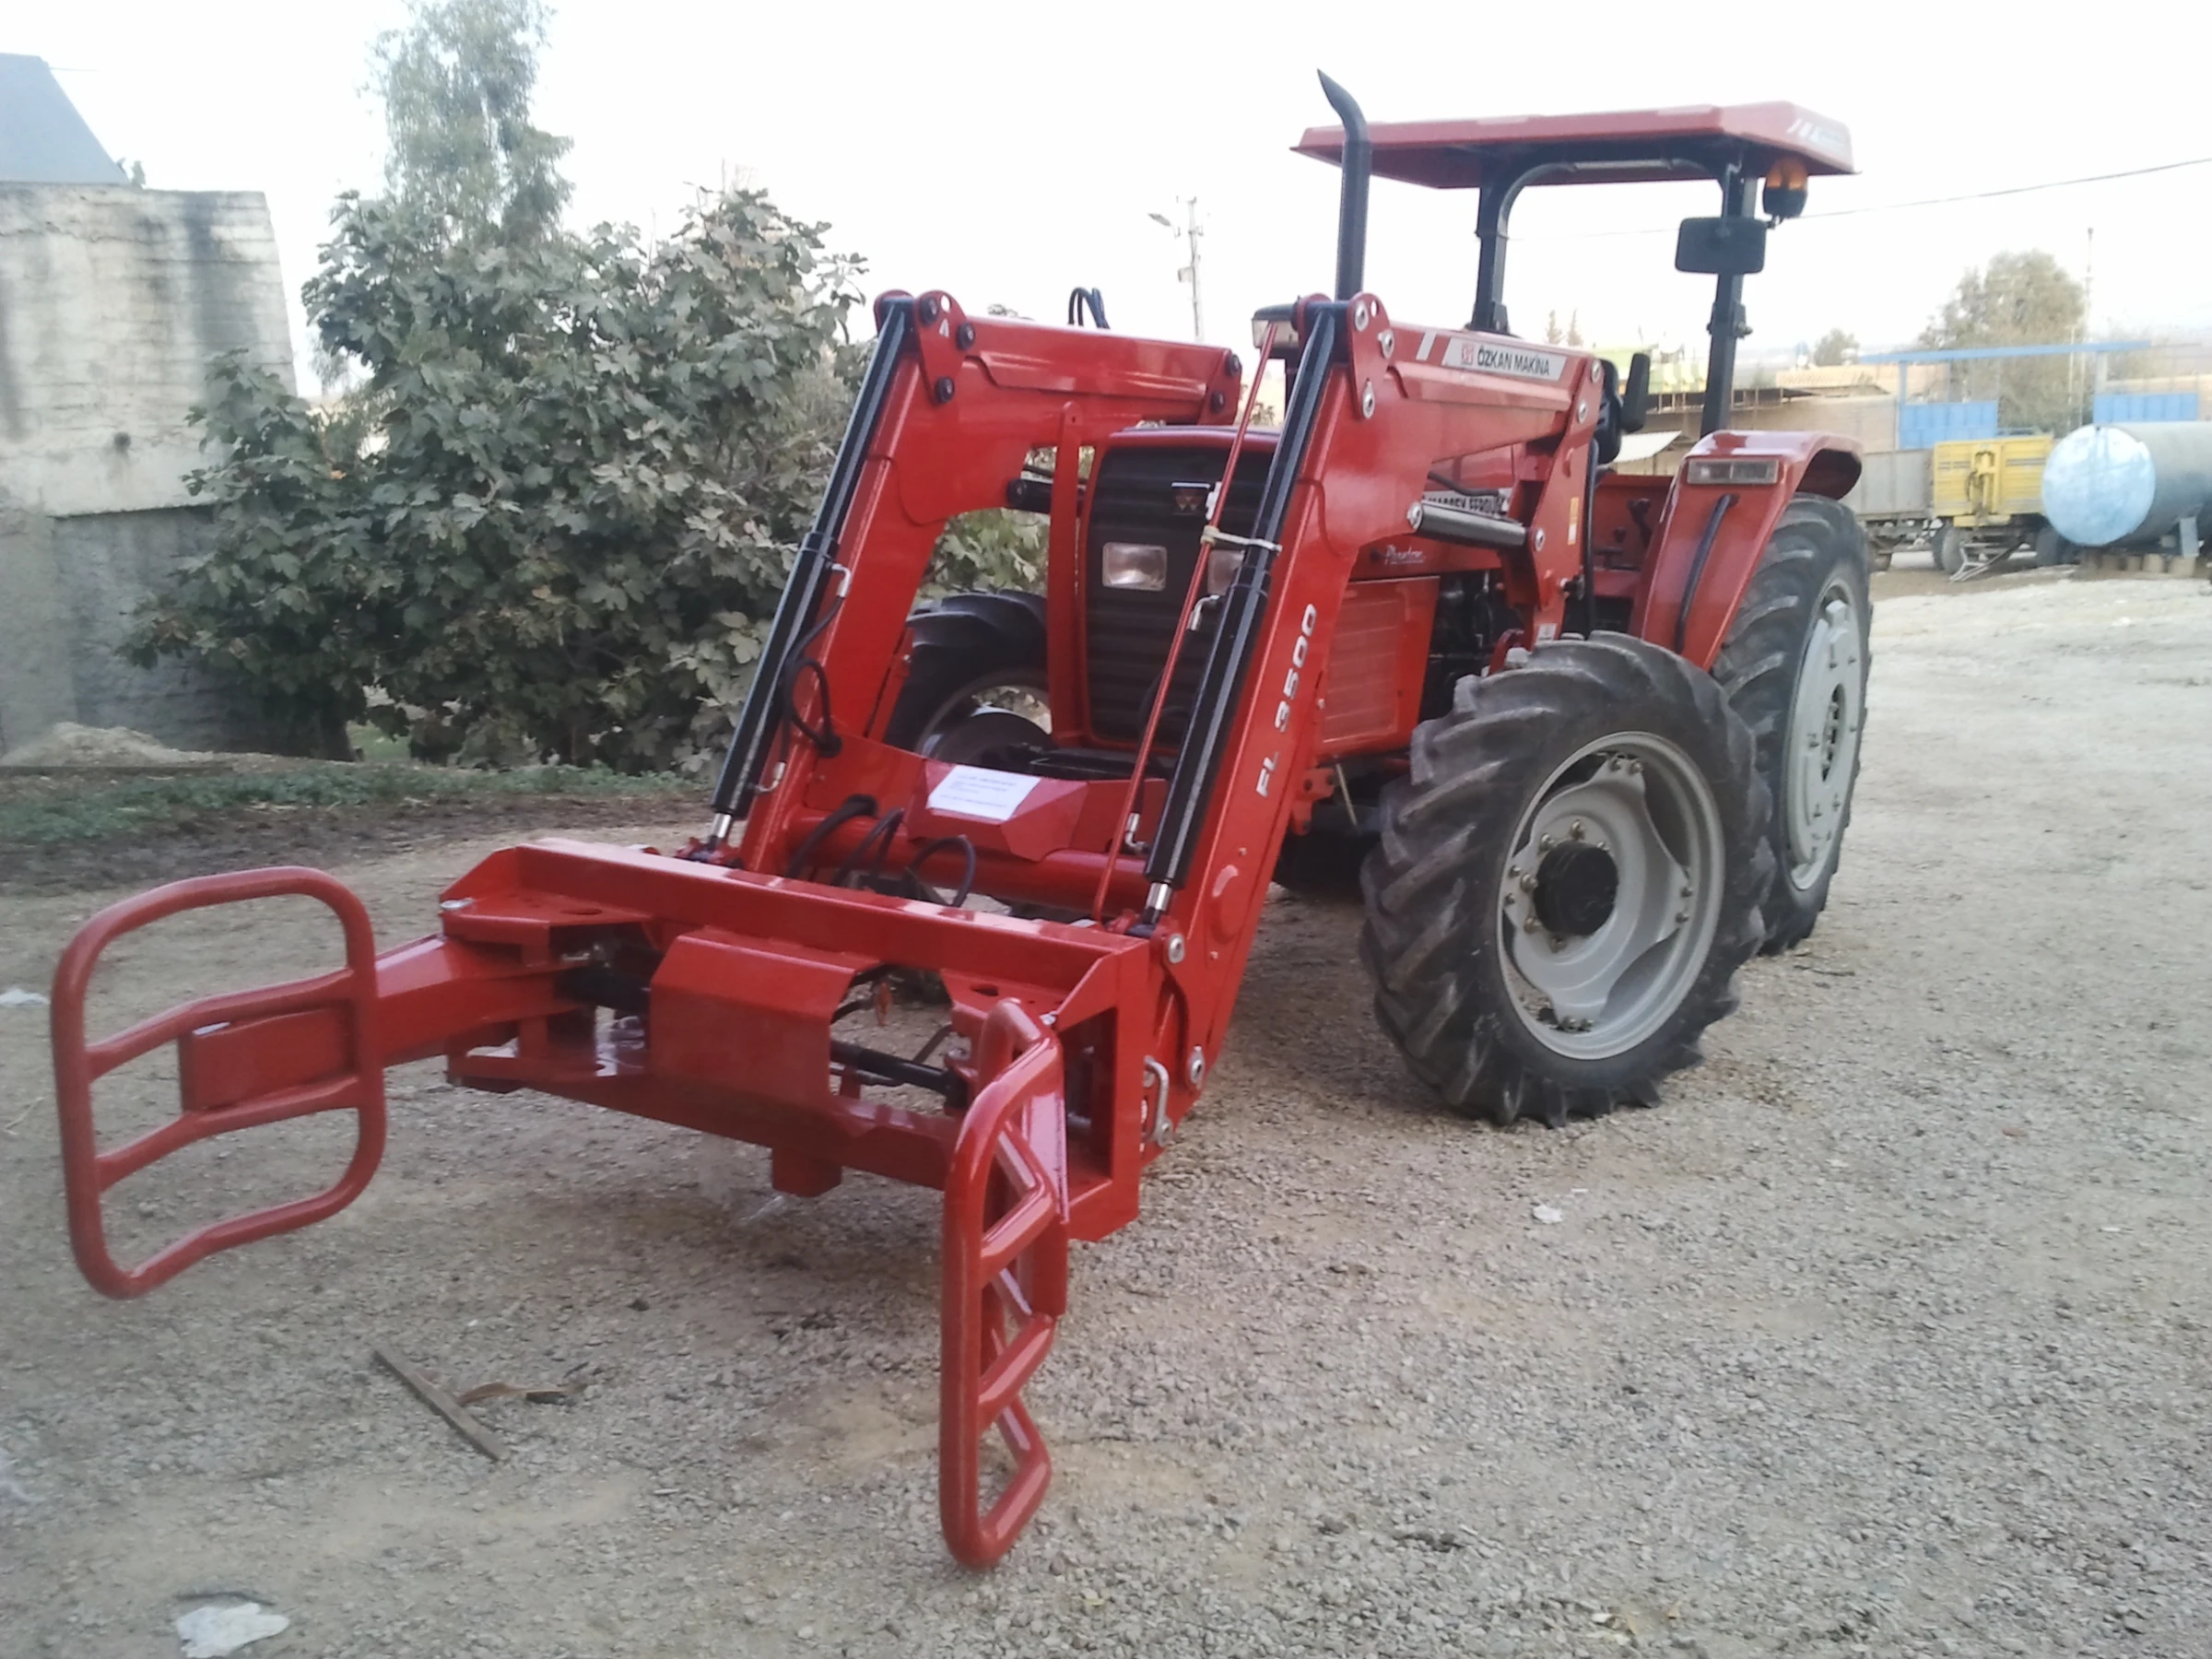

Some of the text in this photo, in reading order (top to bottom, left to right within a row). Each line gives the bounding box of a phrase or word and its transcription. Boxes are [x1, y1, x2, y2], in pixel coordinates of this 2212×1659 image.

[1477, 345, 1512, 371] ÖZKAN
[1255, 603, 1317, 798] FL 3500
